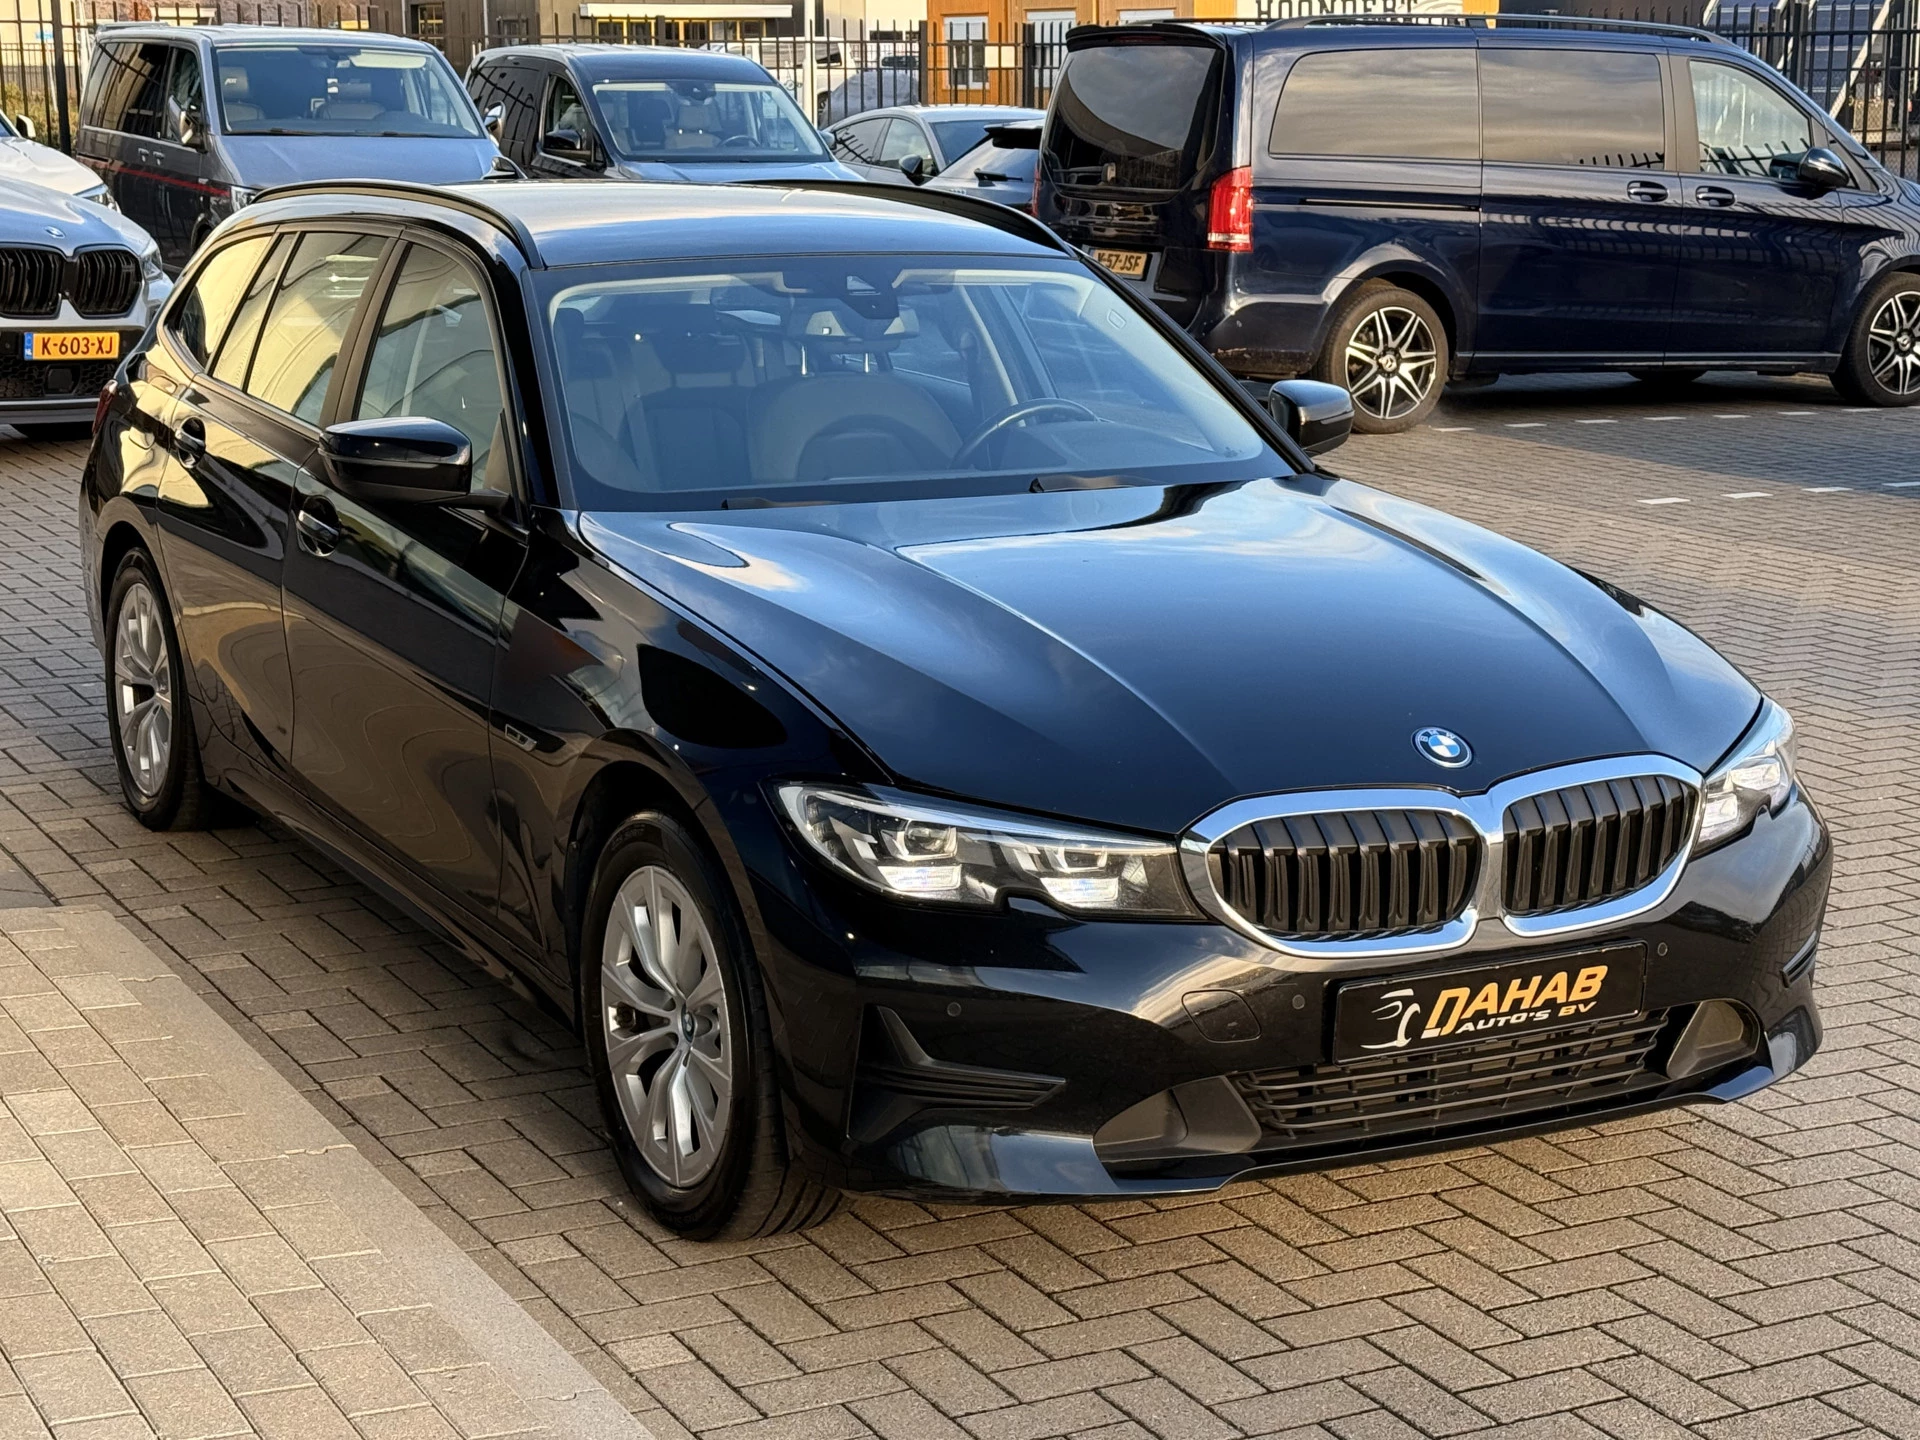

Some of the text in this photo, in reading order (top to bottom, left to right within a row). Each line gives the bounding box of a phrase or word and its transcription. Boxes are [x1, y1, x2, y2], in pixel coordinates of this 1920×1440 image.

[41, 336, 113, 356] K-603-XJ
[1421, 965, 1608, 1040] DAHAB
[1455, 1001, 1597, 1034] AUTO'S BV
